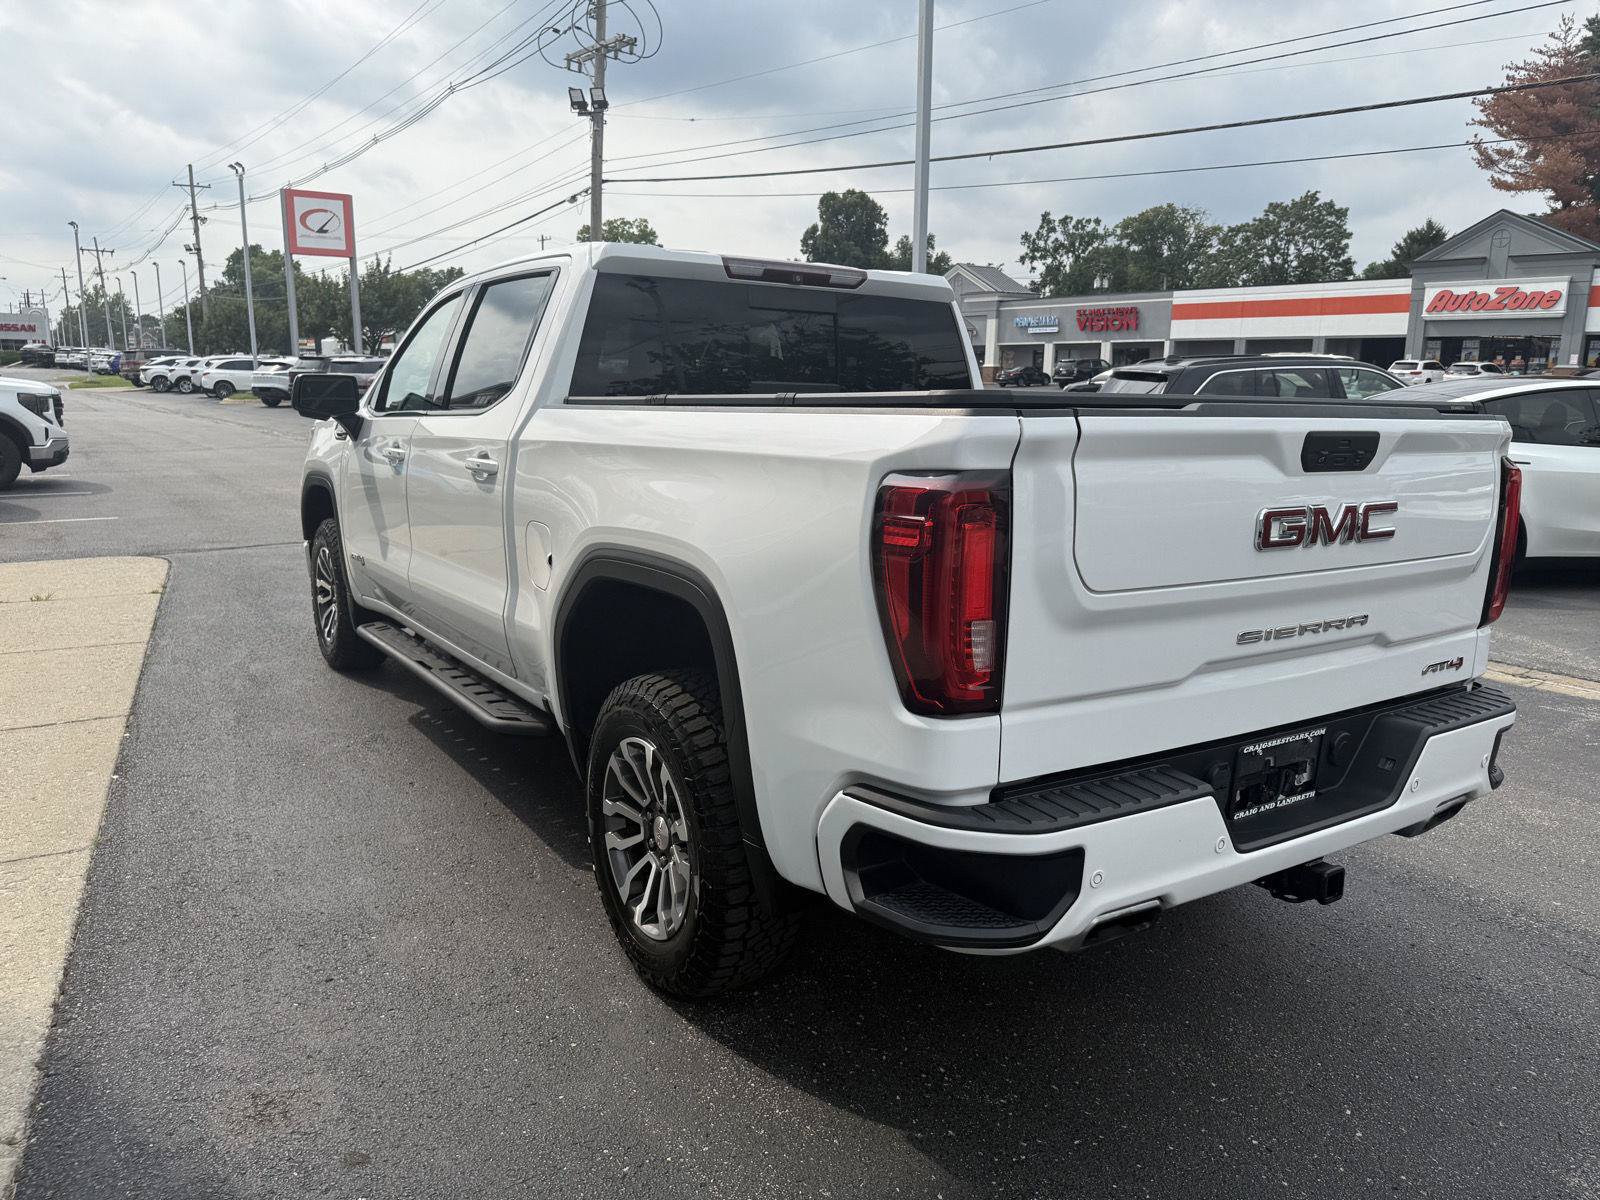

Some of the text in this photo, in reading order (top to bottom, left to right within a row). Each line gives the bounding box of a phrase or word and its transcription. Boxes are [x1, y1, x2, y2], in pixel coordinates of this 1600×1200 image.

[1426, 286, 1563, 313] AutoZone
[1076, 316, 1138, 332] VISION
[1254, 500, 1398, 551] GMC
[1236, 614, 1369, 645] SIERRA
[1243, 728, 1327, 754] CRAIGSBESTCARS.COM
[1233, 790, 1316, 820] CRAIG AND LANDRETH
